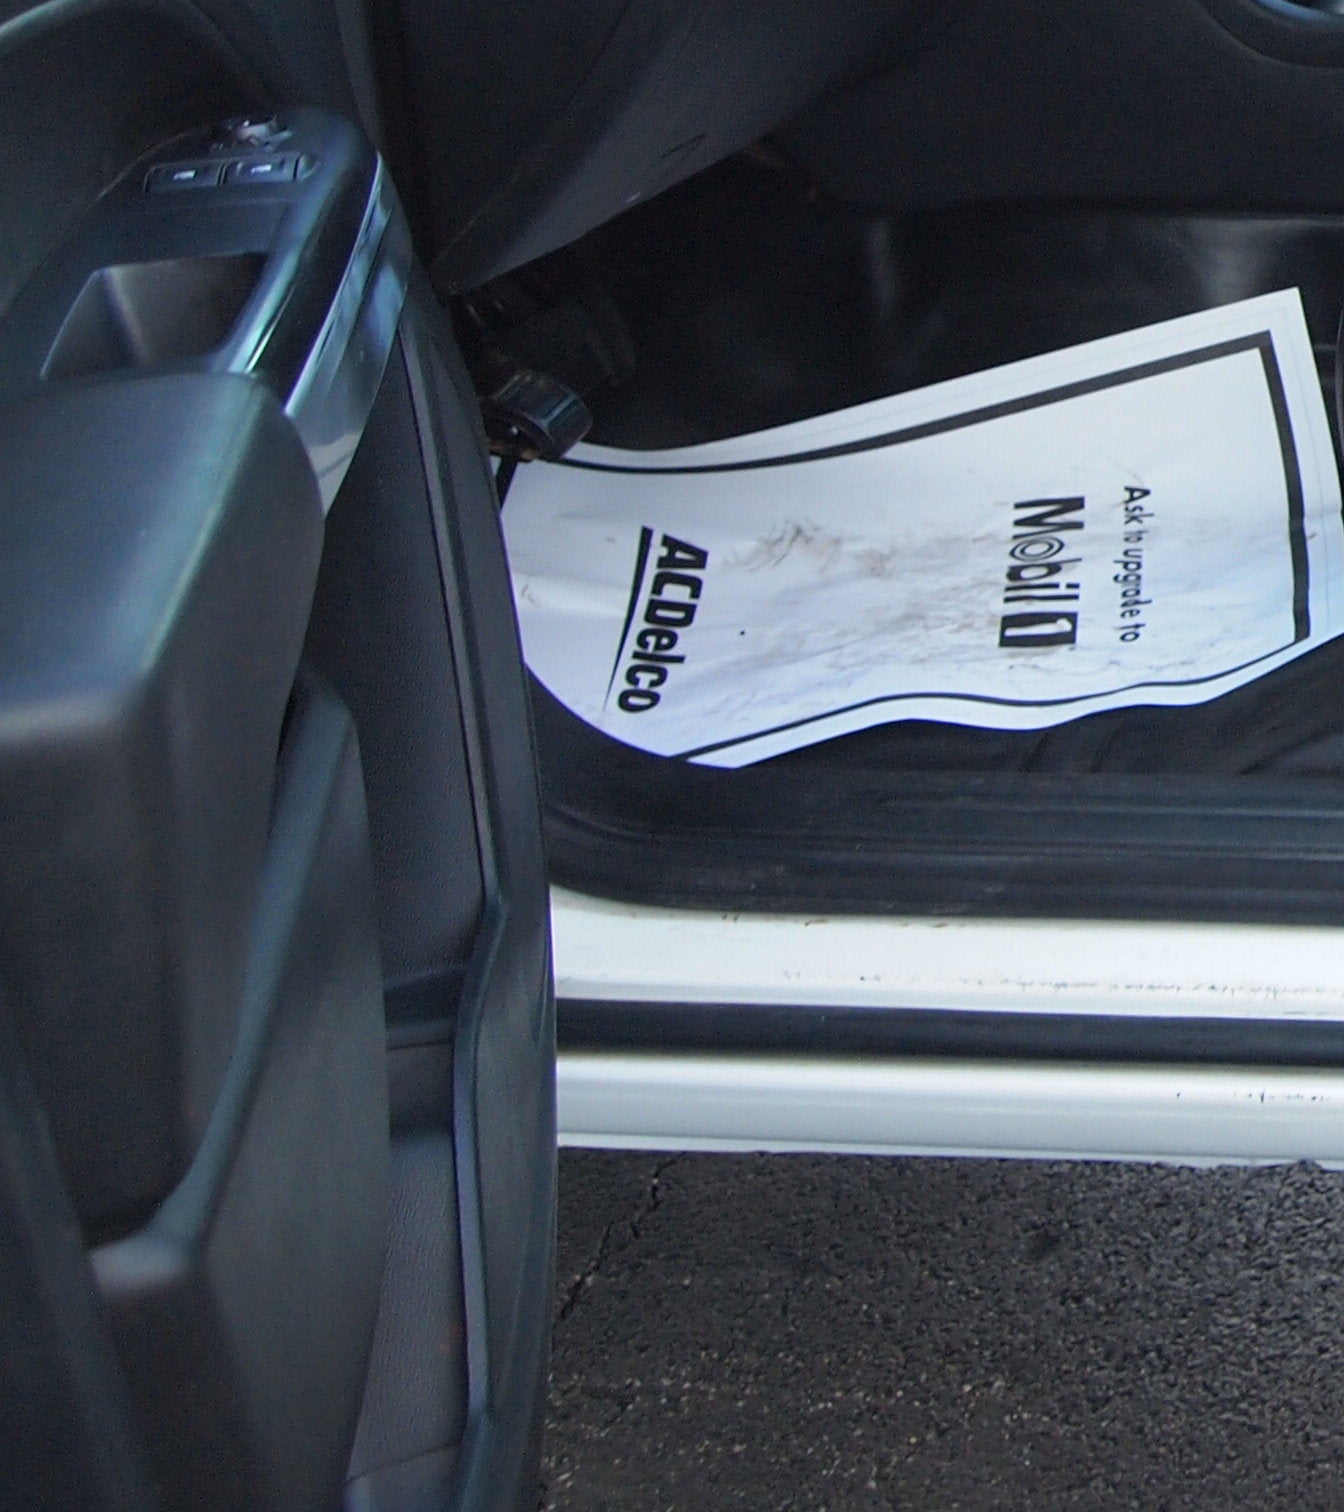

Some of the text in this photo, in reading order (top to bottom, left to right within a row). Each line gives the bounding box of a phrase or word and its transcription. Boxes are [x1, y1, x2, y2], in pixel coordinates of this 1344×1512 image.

[617, 533, 709, 714] ACDelco
[1003, 496, 1085, 603] Mobil
[1112, 486, 1154, 643] Ask to upgrade to
